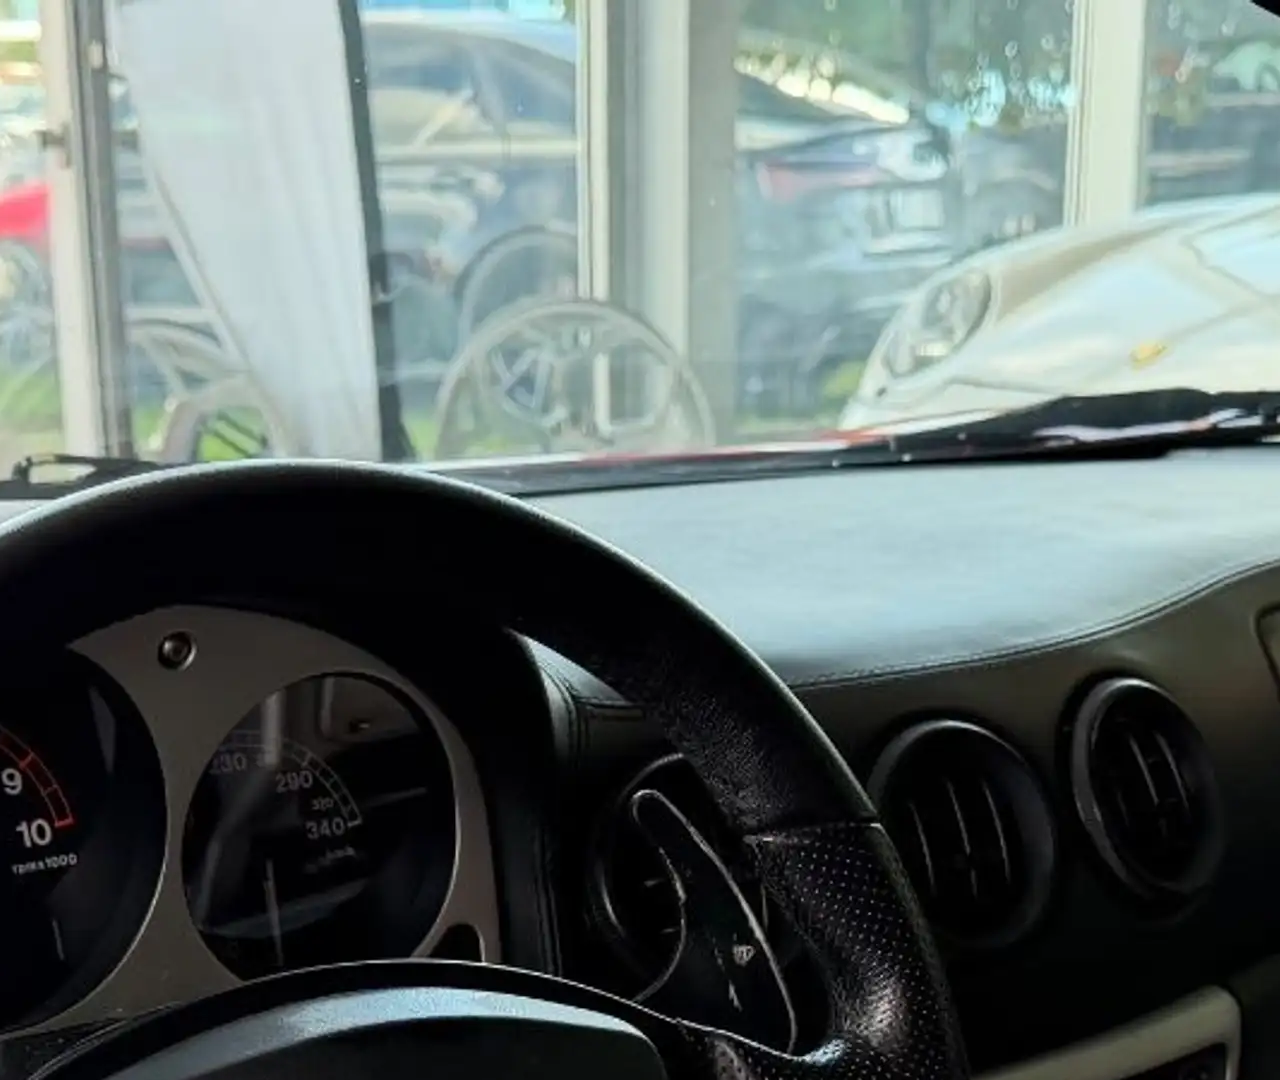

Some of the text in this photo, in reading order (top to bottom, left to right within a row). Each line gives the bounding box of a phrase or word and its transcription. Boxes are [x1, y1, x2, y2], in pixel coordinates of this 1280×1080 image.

[0, 767, 23, 797] 9
[276, 770, 313, 794] 290
[15, 817, 53, 849] 10
[305, 816, 346, 841] 340
